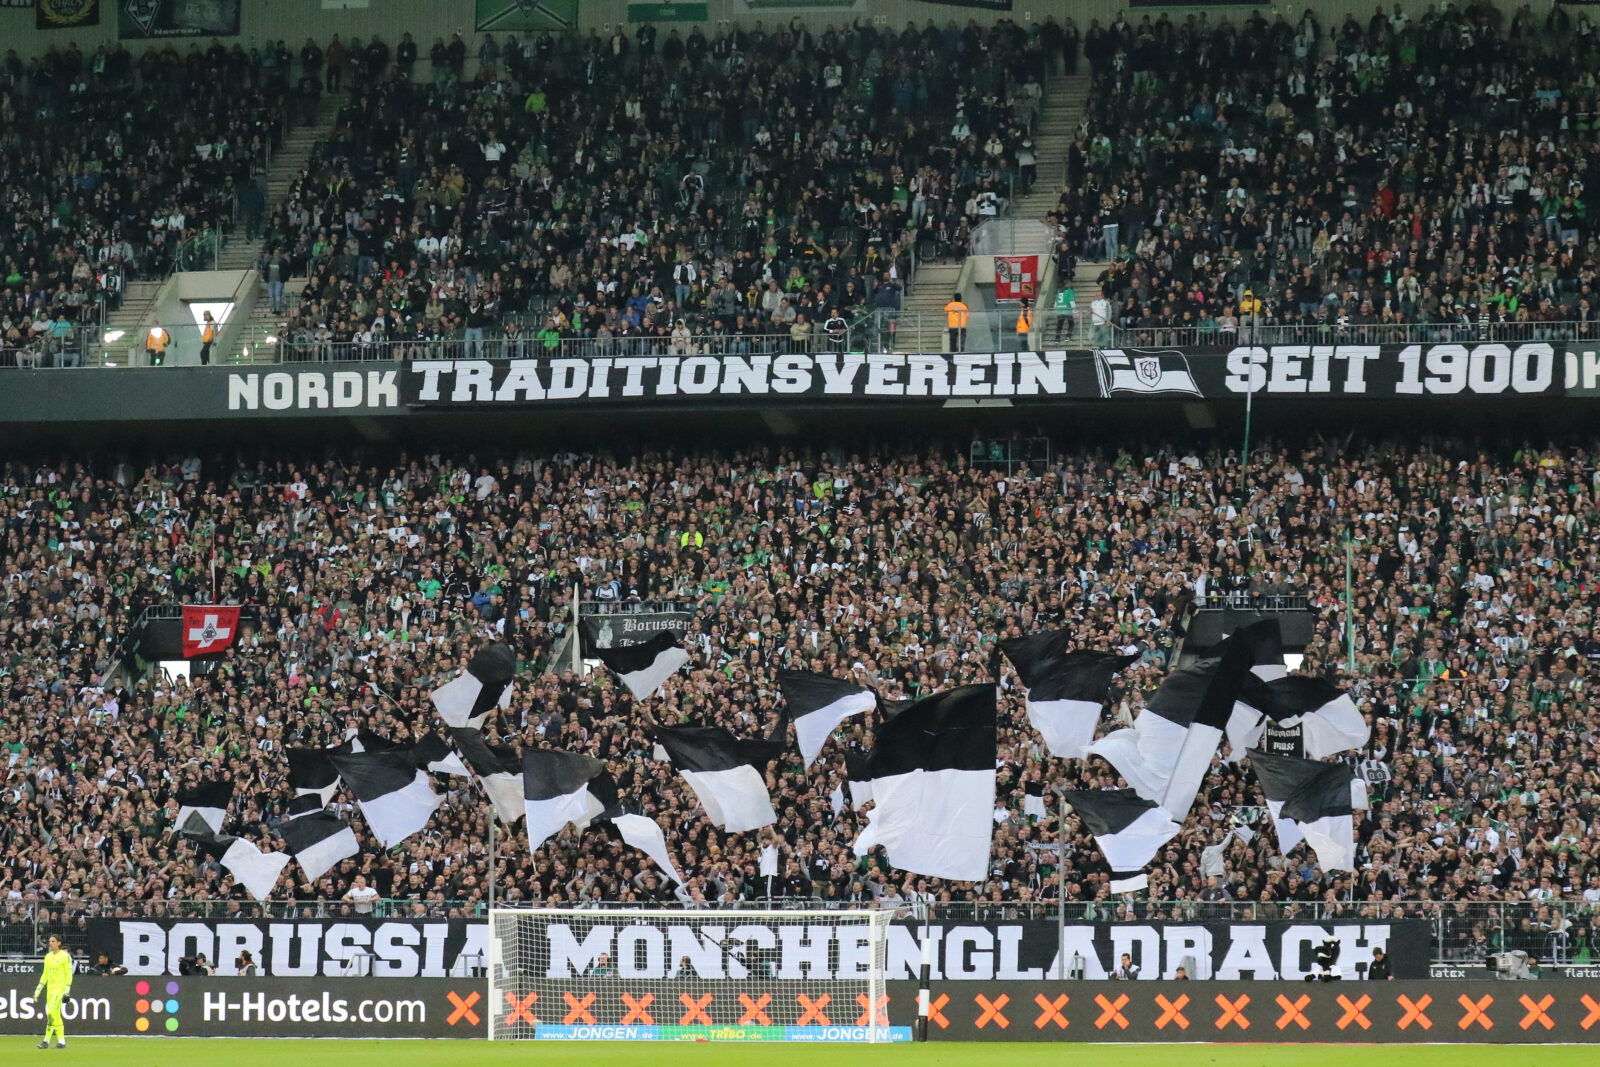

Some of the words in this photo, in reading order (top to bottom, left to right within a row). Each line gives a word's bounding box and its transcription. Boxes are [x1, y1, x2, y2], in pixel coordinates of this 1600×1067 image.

[411, 351, 1067, 402] TRADITIONSVEREIN
[1225, 345, 1381, 394] SEIT
[1396, 343, 1554, 393] 1900
[120, 921, 510, 978] BORUSSIA
[546, 918, 1391, 981] MÖNCHENGLADBACH
[0, 963, 34, 973] latex
[1430, 968, 1466, 978] latex
[1564, 967, 1600, 978] flate
[203, 992, 426, 1022] H-Hotels.com
[568, 1027, 638, 1040] JONGEN
